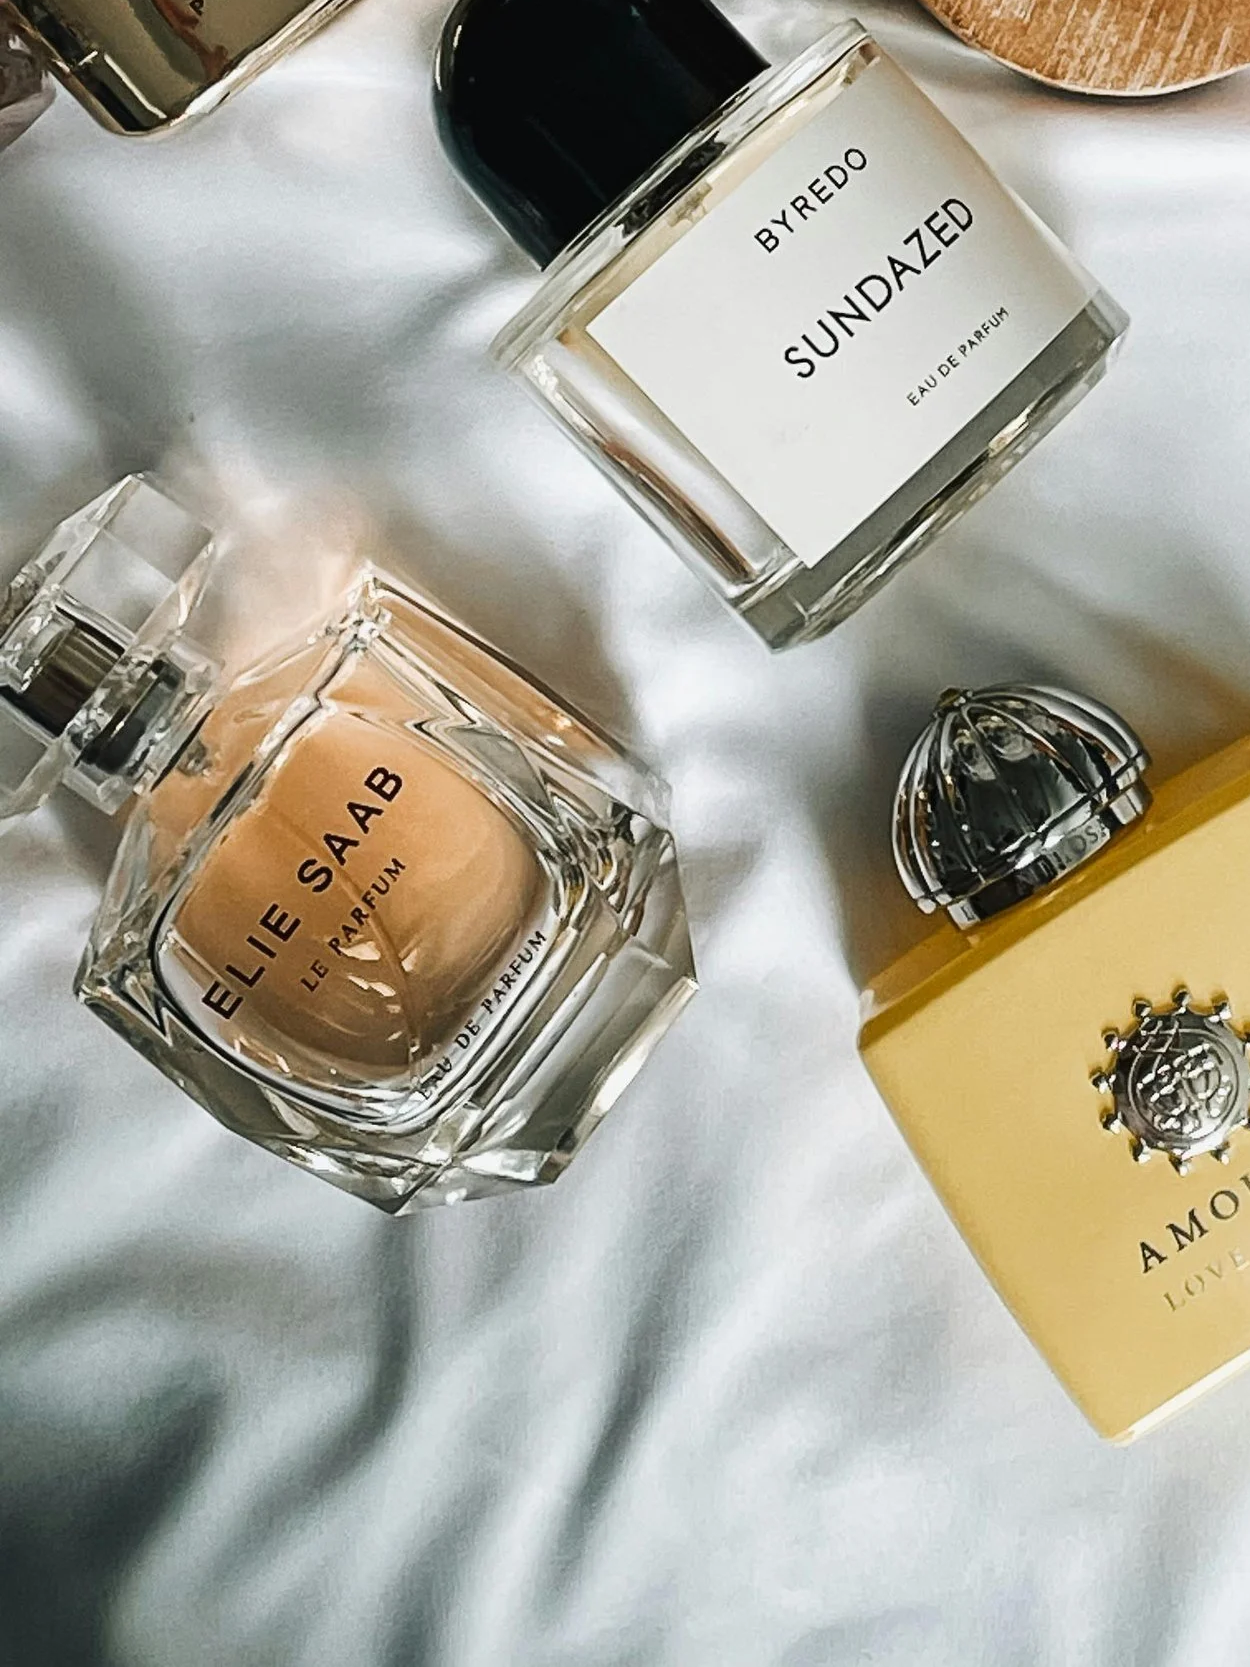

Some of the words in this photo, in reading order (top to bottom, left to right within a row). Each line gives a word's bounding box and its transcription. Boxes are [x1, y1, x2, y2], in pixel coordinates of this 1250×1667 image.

[754, 148, 867, 253] BYREDO
[784, 198, 973, 379] SUNDAZED
[906, 374, 938, 407] EAU
[937, 354, 960, 378] DE
[959, 306, 1010, 358] PARFUM
[201, 903, 301, 1020] ELIE
[298, 766, 403, 893] SAAB
[300, 959, 329, 993] LE
[328, 858, 406, 956] PARFUM
[455, 1017, 481, 1050] DE
[480, 930, 547, 1013] PARFUM
[1163, 1247, 1250, 1311] LOVE
